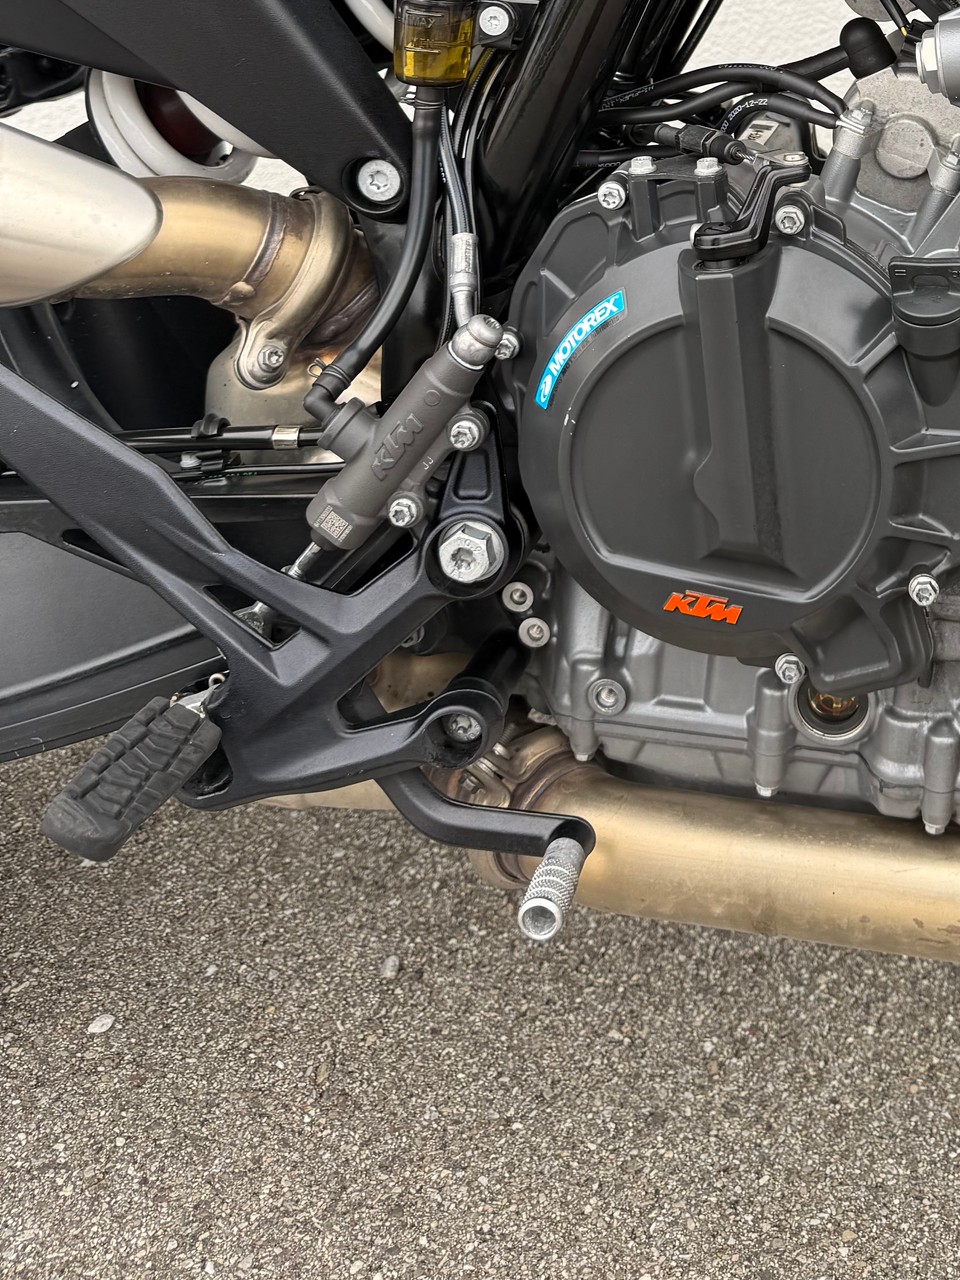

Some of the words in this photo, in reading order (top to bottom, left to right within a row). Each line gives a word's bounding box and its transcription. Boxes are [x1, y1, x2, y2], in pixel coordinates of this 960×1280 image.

[727, 98, 768, 121] 2020-12-22
[548, 294, 620, 377] MOTOREX
[371, 412, 424, 482] KTM
[663, 589, 744, 626] KTM
